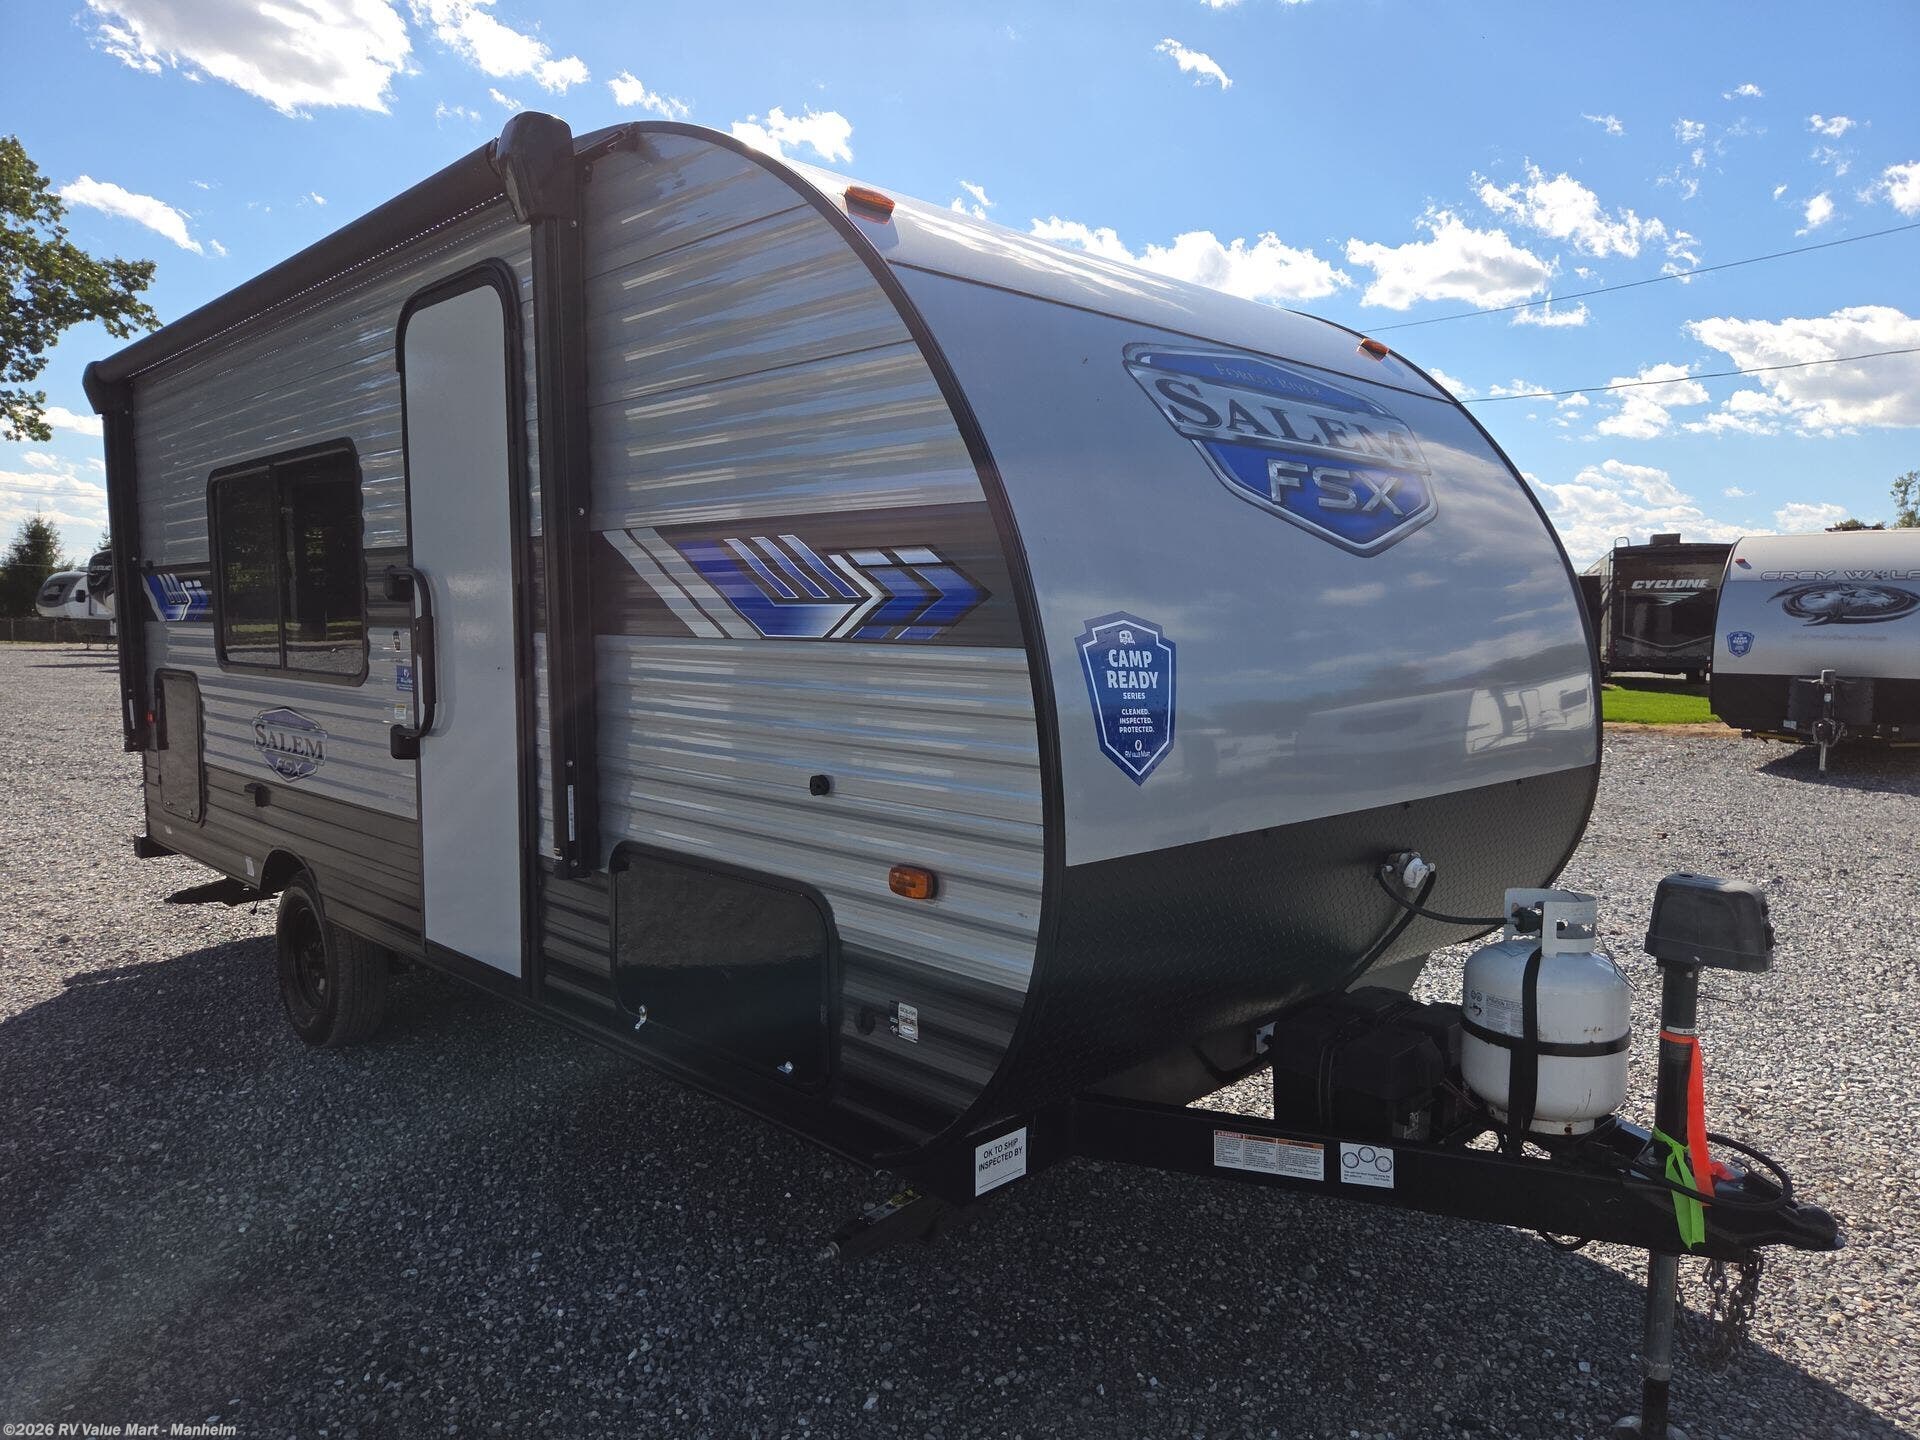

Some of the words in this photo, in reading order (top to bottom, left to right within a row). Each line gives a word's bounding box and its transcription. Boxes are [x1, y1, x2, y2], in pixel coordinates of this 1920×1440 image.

[1155, 378, 1422, 463] SALEM
[1267, 458, 1405, 515] FSX
[1631, 579, 1710, 589] CYCLONE
[1760, 570, 1836, 582] GREY
[1108, 649, 1152, 668] CAMP
[1107, 670, 1158, 689] READY
[1123, 692, 1145, 700] SERIES
[253, 723, 324, 760] SALEM
[275, 757, 304, 776] FSX
[983, 1148, 993, 1159] OK
[994, 1144, 1003, 1155] TO
[1004, 1137, 1019, 1150] SHIP
[978, 1150, 1014, 1172] INSPECTED
[1014, 1146, 1023, 1157] BY
